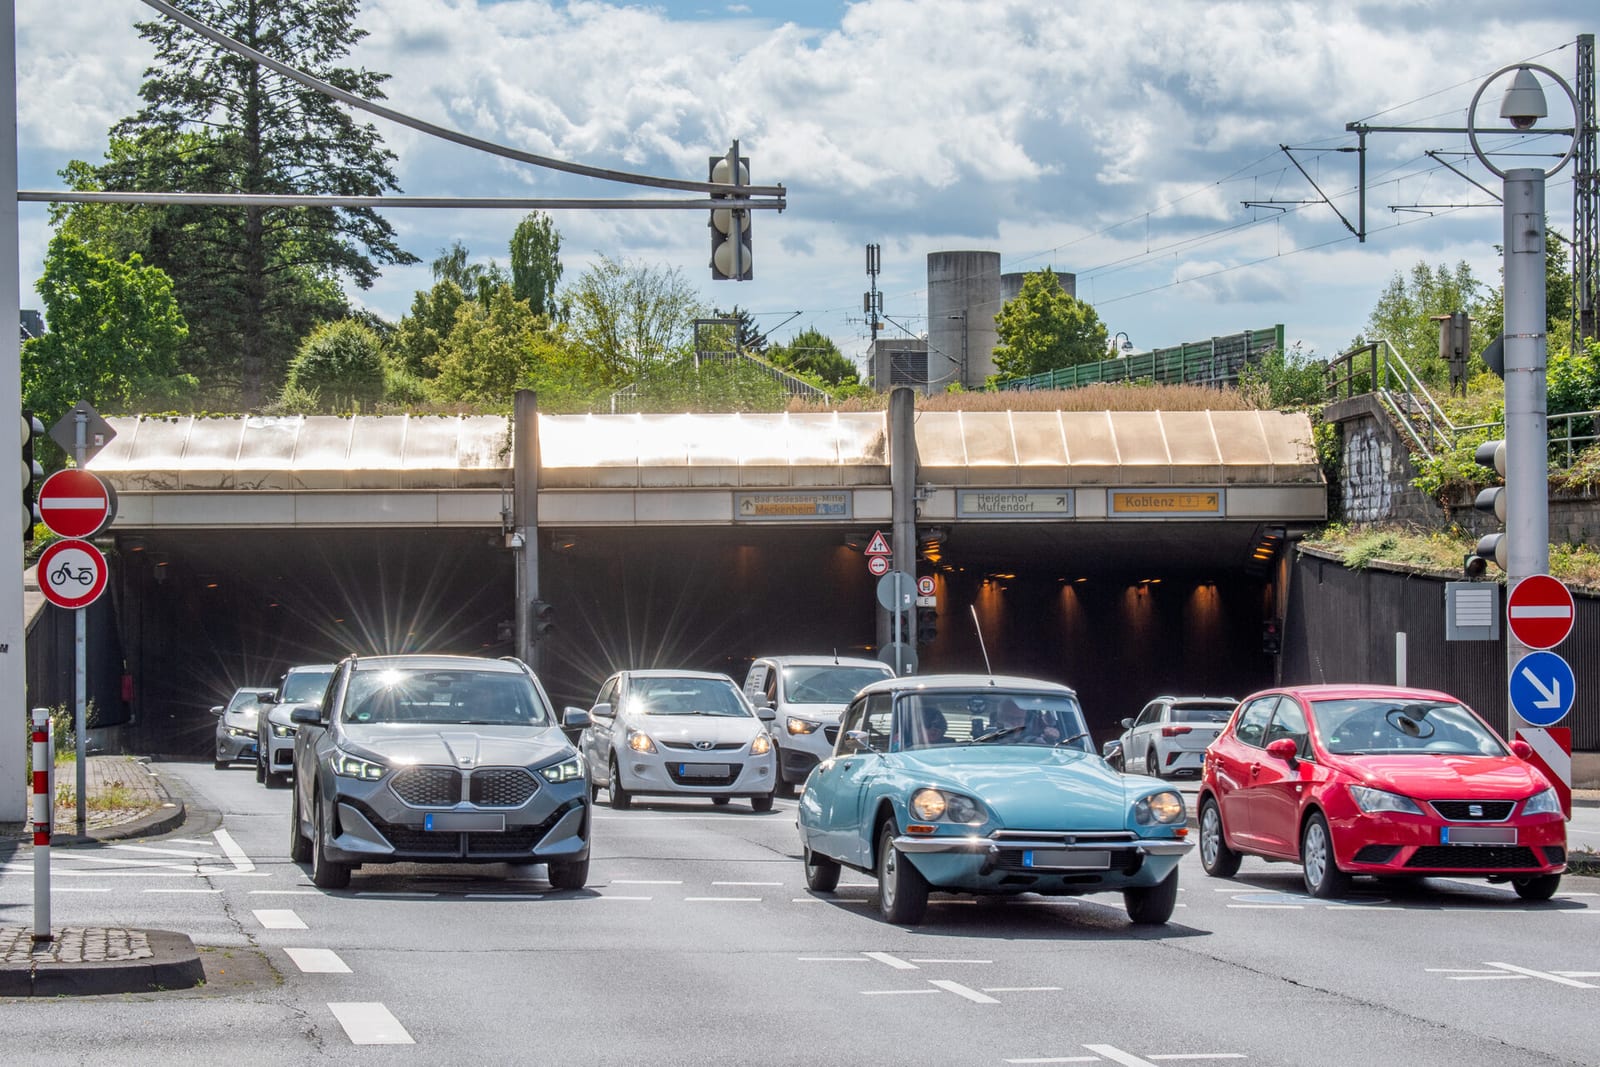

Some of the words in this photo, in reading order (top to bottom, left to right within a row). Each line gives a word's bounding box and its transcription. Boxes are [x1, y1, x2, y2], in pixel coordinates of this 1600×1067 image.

[754, 495, 770, 504] Bad
[977, 493, 1028, 502] Heiderhof
[1125, 496, 1175, 508] Koblenz
[755, 504, 816, 513] Meckenheim
[977, 502, 1034, 511] Muffendorf
